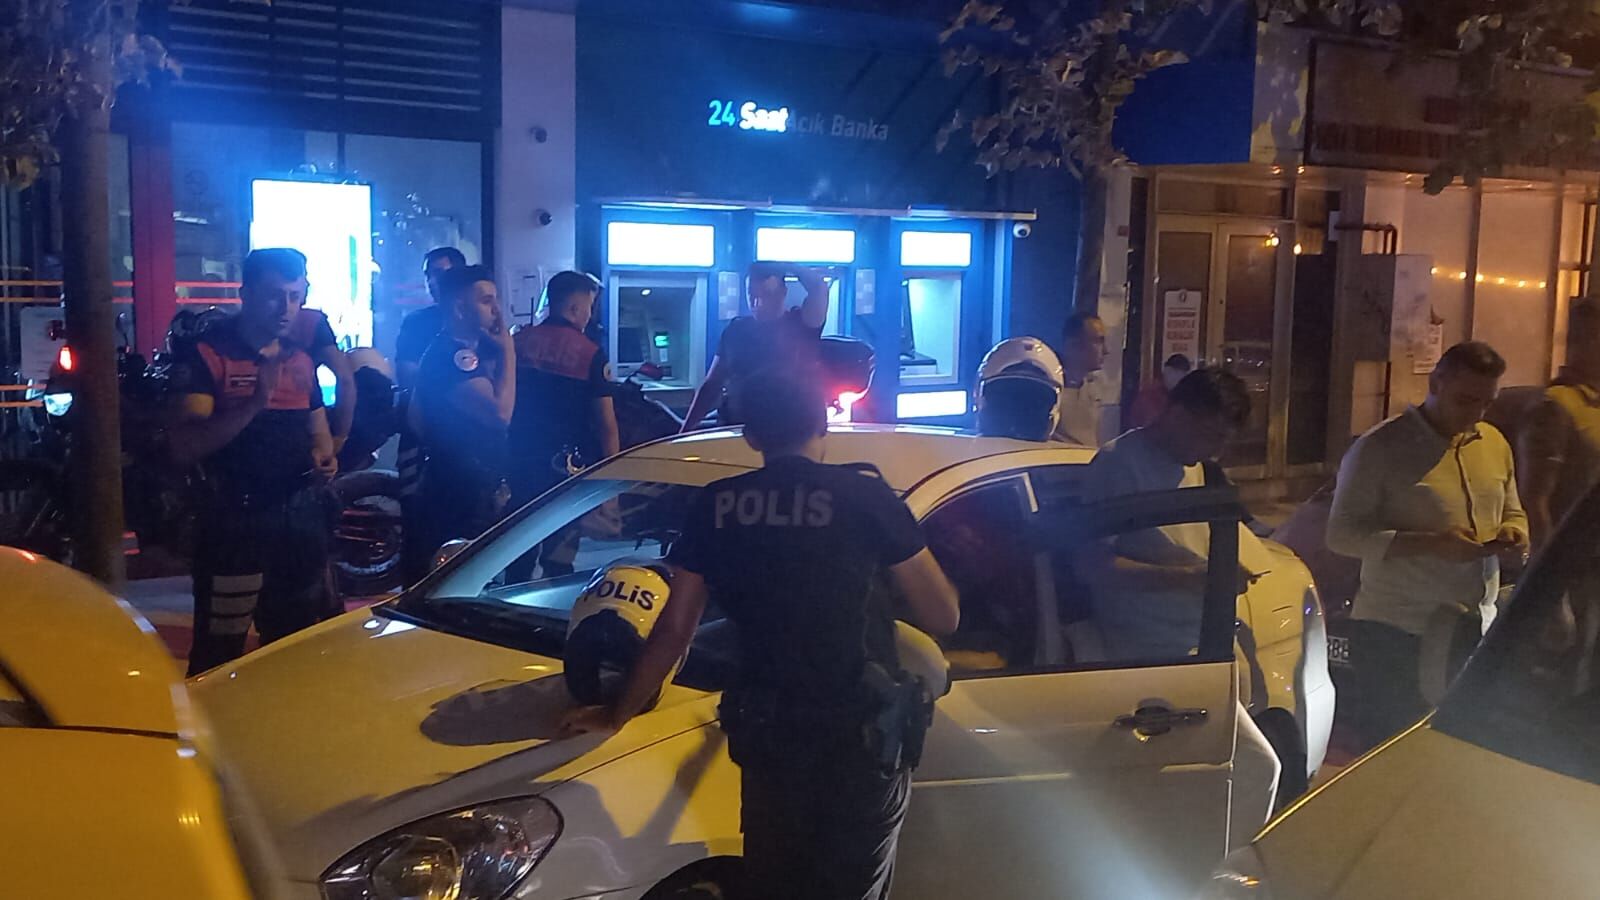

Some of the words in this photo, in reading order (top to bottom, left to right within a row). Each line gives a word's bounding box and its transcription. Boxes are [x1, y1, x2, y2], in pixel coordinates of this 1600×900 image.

[708, 99, 736, 127] 24
[739, 101, 789, 132] Saat
[831, 114, 889, 141] Banka
[715, 485, 833, 529] POLİS
